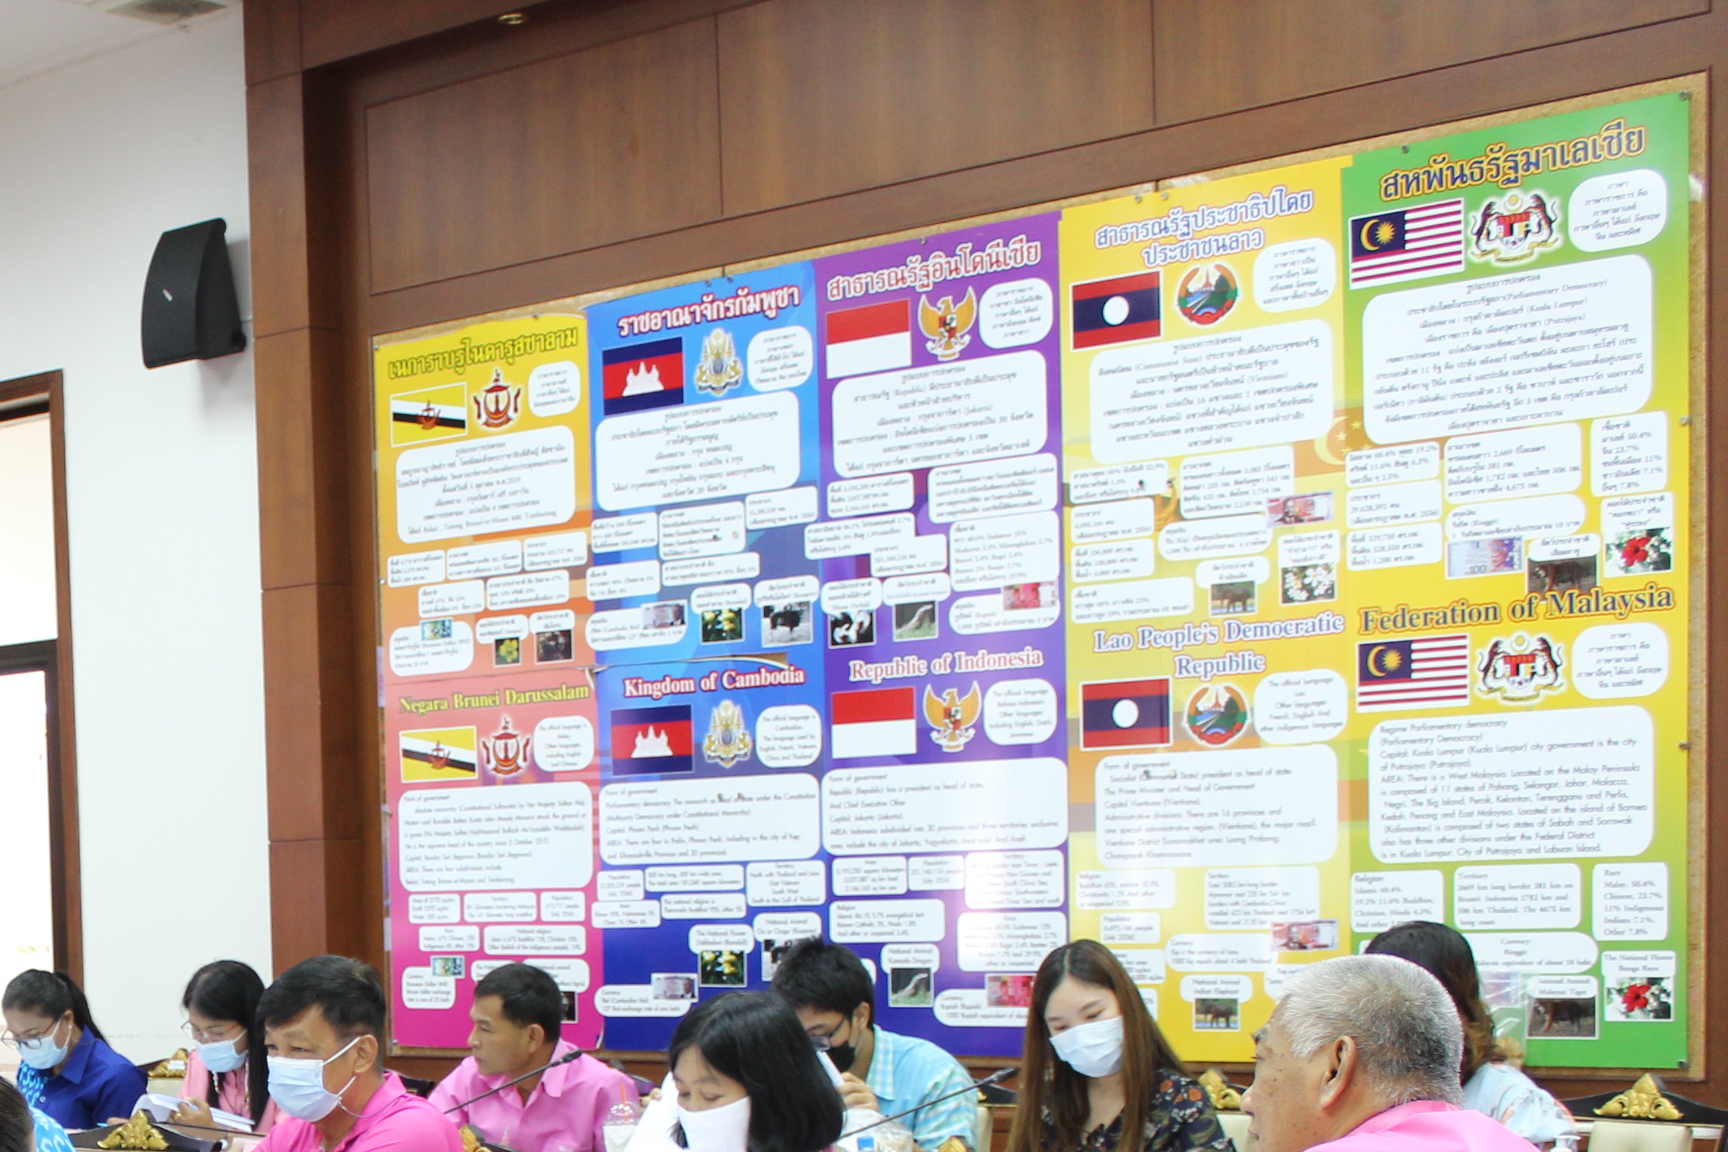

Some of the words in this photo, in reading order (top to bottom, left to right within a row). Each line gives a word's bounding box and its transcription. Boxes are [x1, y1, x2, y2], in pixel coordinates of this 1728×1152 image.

[1379, 117, 1648, 202] สหพันธรัฐมาเลเซีย
[1095, 186, 1314, 249] สาธารณรัฐประชาธิปไตย
[827, 234, 1042, 301] สาธารณรัฐอินโดนีเซีย
[1142, 228, 1265, 267] ประชาชนลาว
[618, 285, 801, 338] ราชอาณาจักรกัมพูชา
[1359, 598, 1502, 635] Federation
[1507, 595, 1541, 623] of
[1545, 582, 1676, 618] Malaysia
[1094, 629, 1133, 652] Lao
[1138, 622, 1219, 650] People's
[1223, 611, 1345, 642] Democratic
[624, 675, 695, 699] Kingdom
[700, 672, 718, 691] of
[722, 665, 806, 690] Cambodia
[849, 655, 928, 684] Republic
[930, 652, 953, 674] of
[955, 646, 1044, 673] Indonesia
[1175, 651, 1266, 680] Republic
[400, 696, 449, 714] Negara
[453, 690, 501, 709] Brunei
[505, 684, 590, 705] Darussalam
